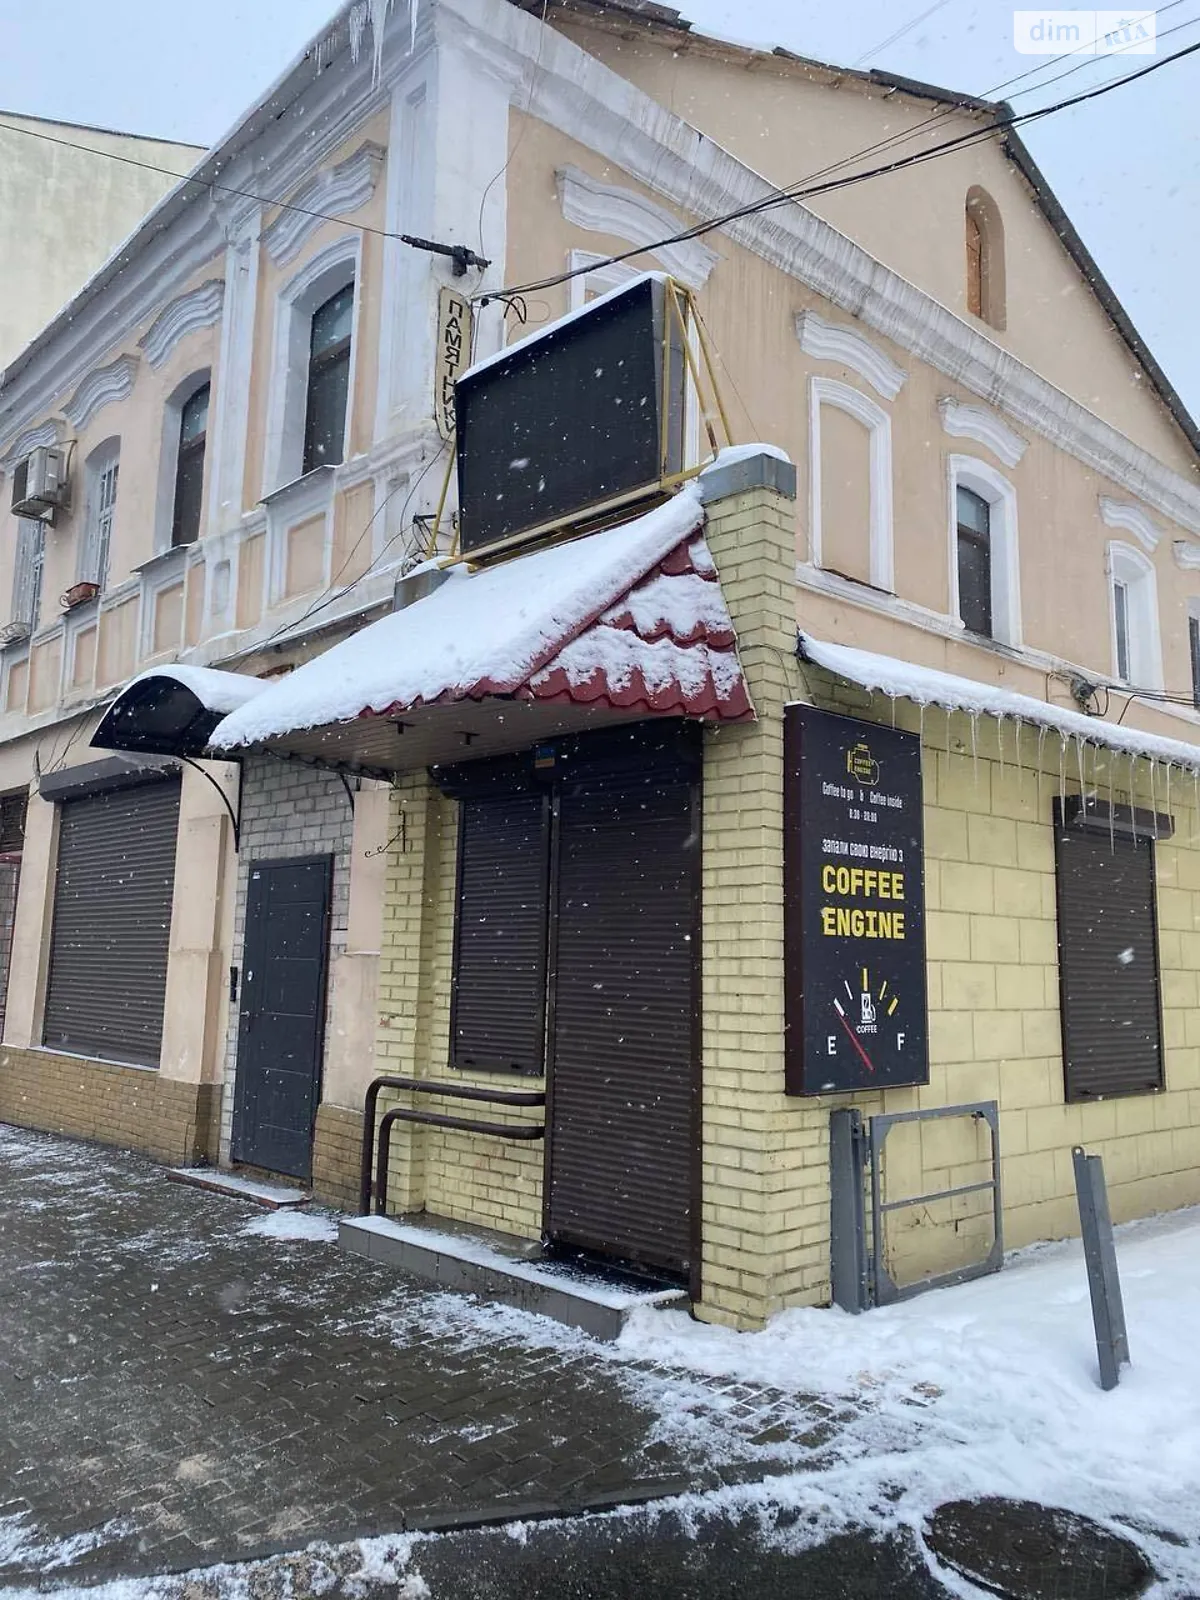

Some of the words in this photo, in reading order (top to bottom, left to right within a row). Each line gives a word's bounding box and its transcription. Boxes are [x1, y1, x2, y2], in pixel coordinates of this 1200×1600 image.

[822, 781, 840, 798] Coffee
[840, 785, 847, 799] to
[847, 789, 854, 801] go
[869, 791, 887, 806] Coffee
[822, 865, 905, 900] COFFEE
[822, 907, 905, 940] ENGINE
[856, 1024, 878, 1034] COFFEE
[828, 1036, 837, 1055] E
[897, 1033, 905, 1051] F
